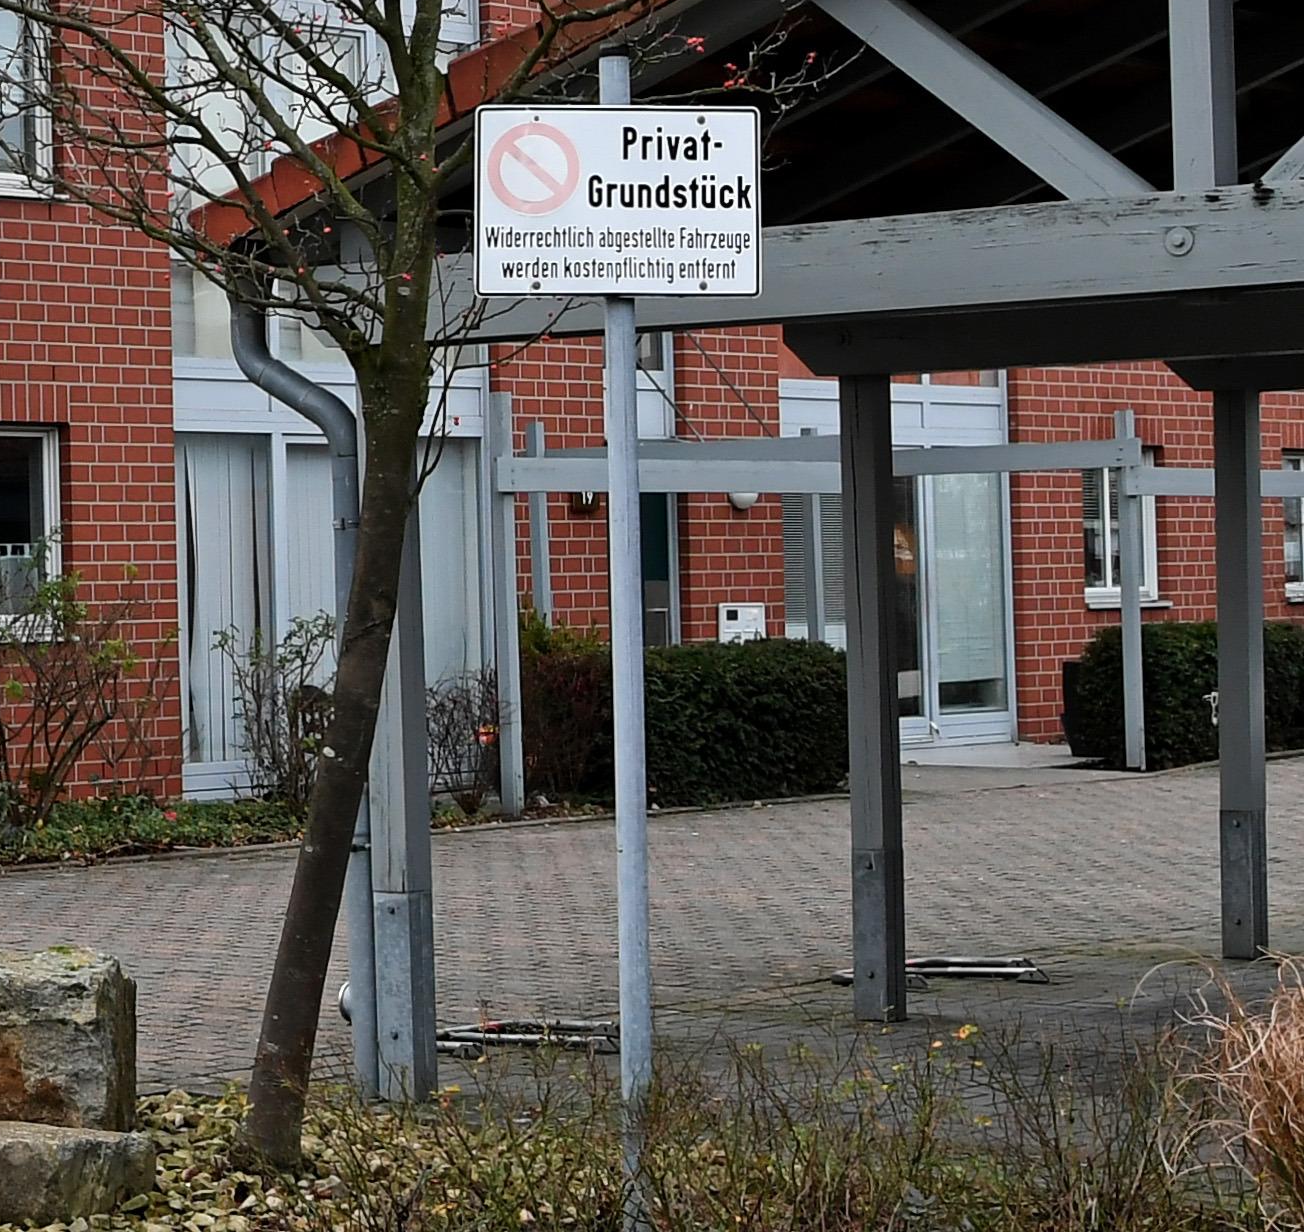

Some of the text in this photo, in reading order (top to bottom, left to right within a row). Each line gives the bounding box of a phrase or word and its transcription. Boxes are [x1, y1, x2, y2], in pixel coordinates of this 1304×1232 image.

[622, 126, 723, 161] Privat-
[588, 174, 752, 209] Grundstück
[485, 226, 751, 253] Widerrechtlich abgestellte Fahrzeuge
[502, 257, 735, 284] werden kostenpflichtig entfernt
[582, 489, 593, 505] 19
